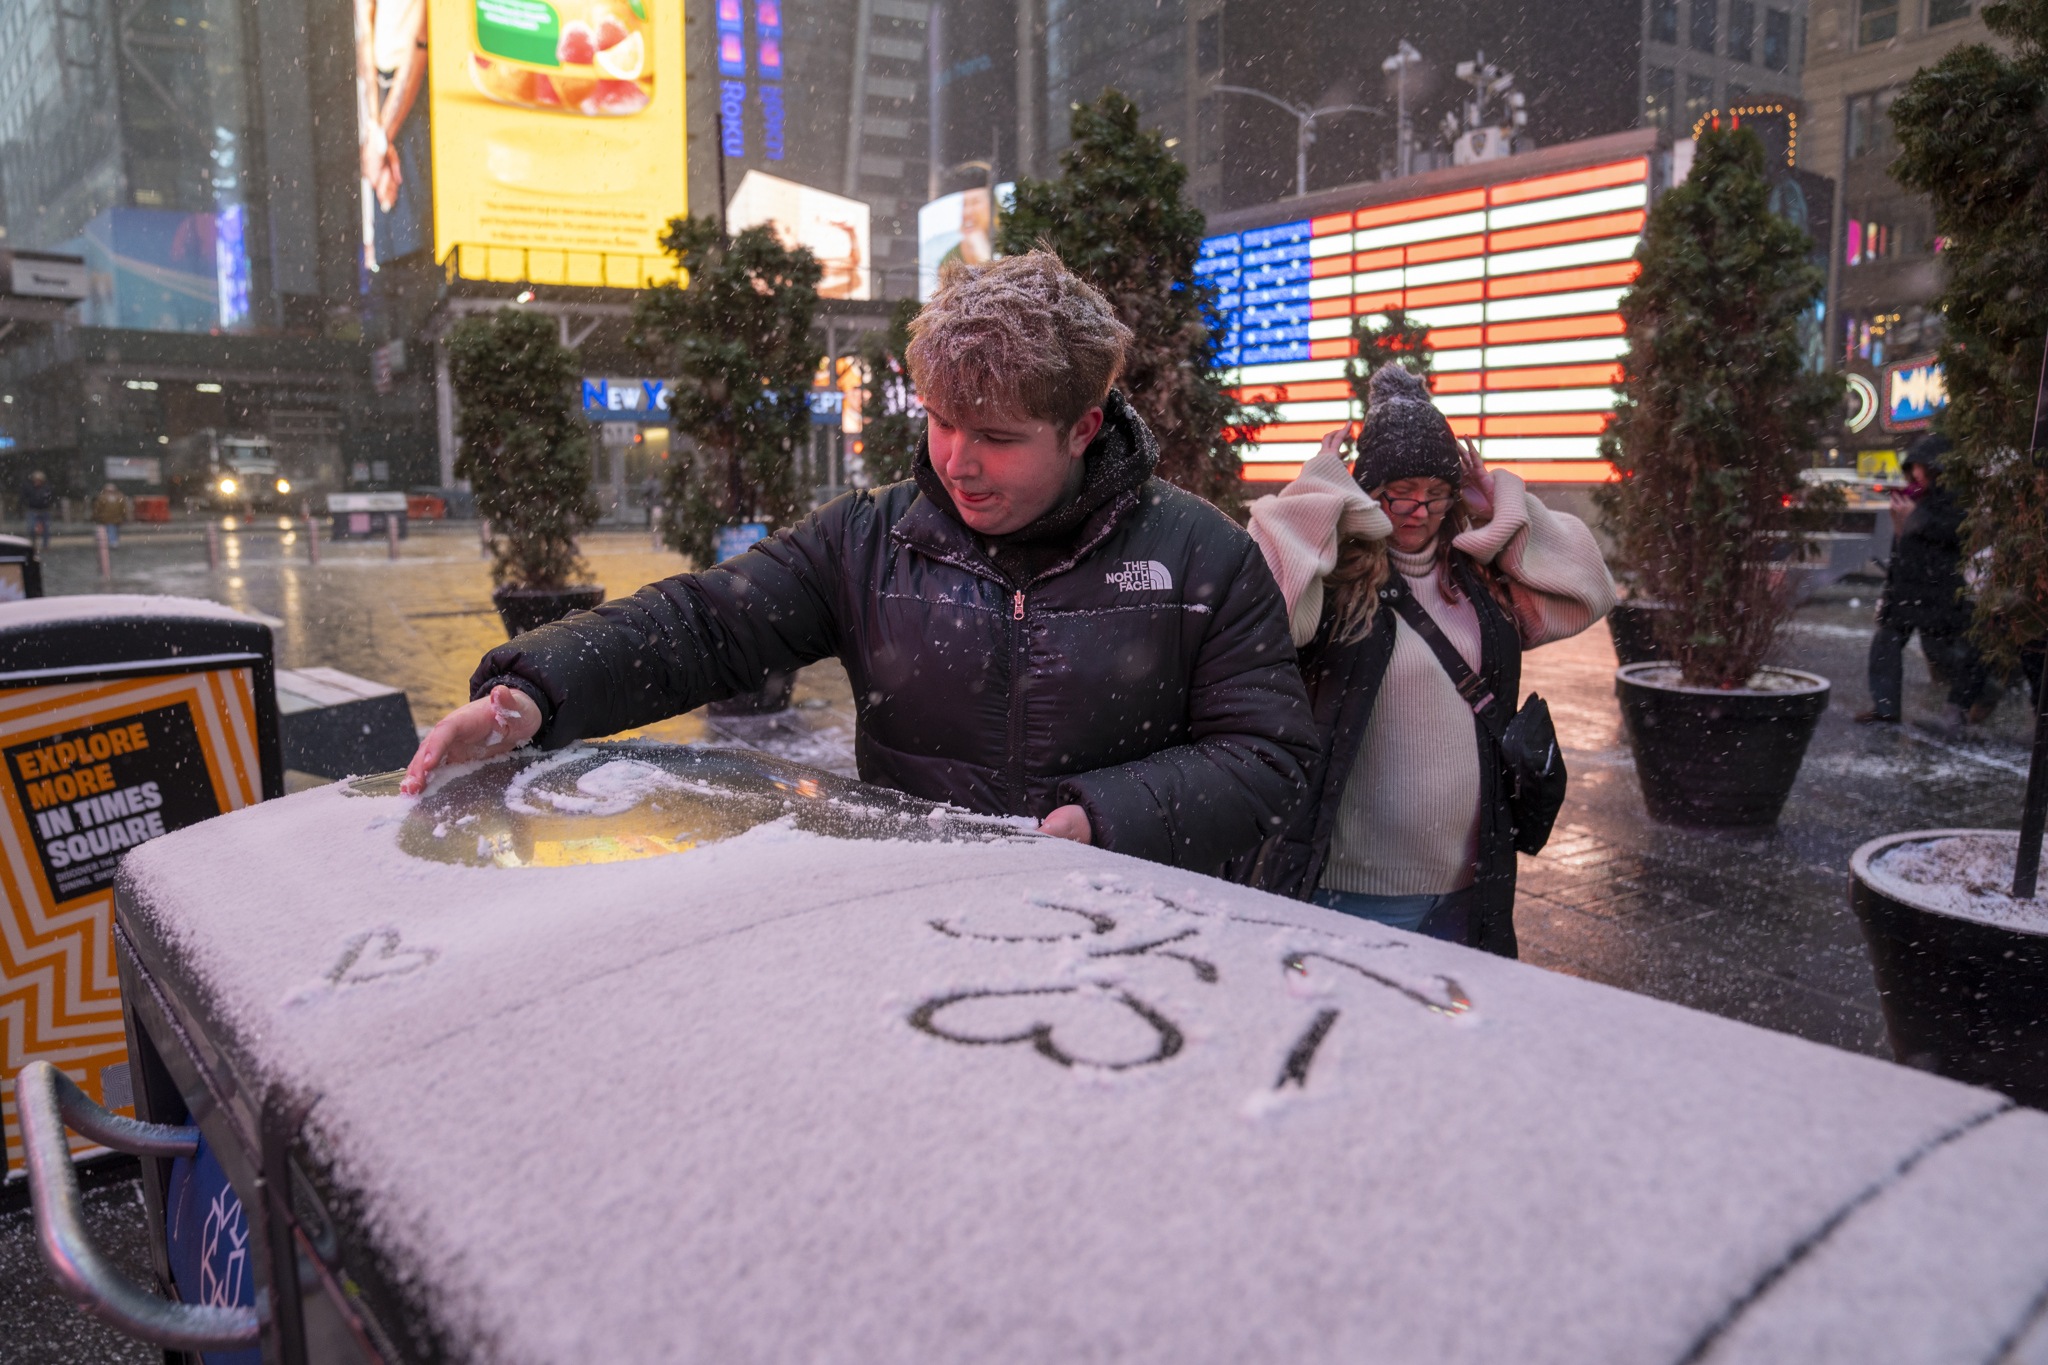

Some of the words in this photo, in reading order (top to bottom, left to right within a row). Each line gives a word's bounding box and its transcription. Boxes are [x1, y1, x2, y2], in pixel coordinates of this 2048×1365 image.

[582, 378, 641, 411] NEW
[1105, 570, 1149, 584] NORTH
[1123, 560, 1148, 571] THE
[1119, 581, 1150, 593] FACE
[16, 722, 149, 780] EXPLORE
[26, 763, 117, 810] MORE
[36, 805, 75, 839] IN
[74, 781, 163, 829] TIMES
[47, 811, 166, 868] SQUARE
